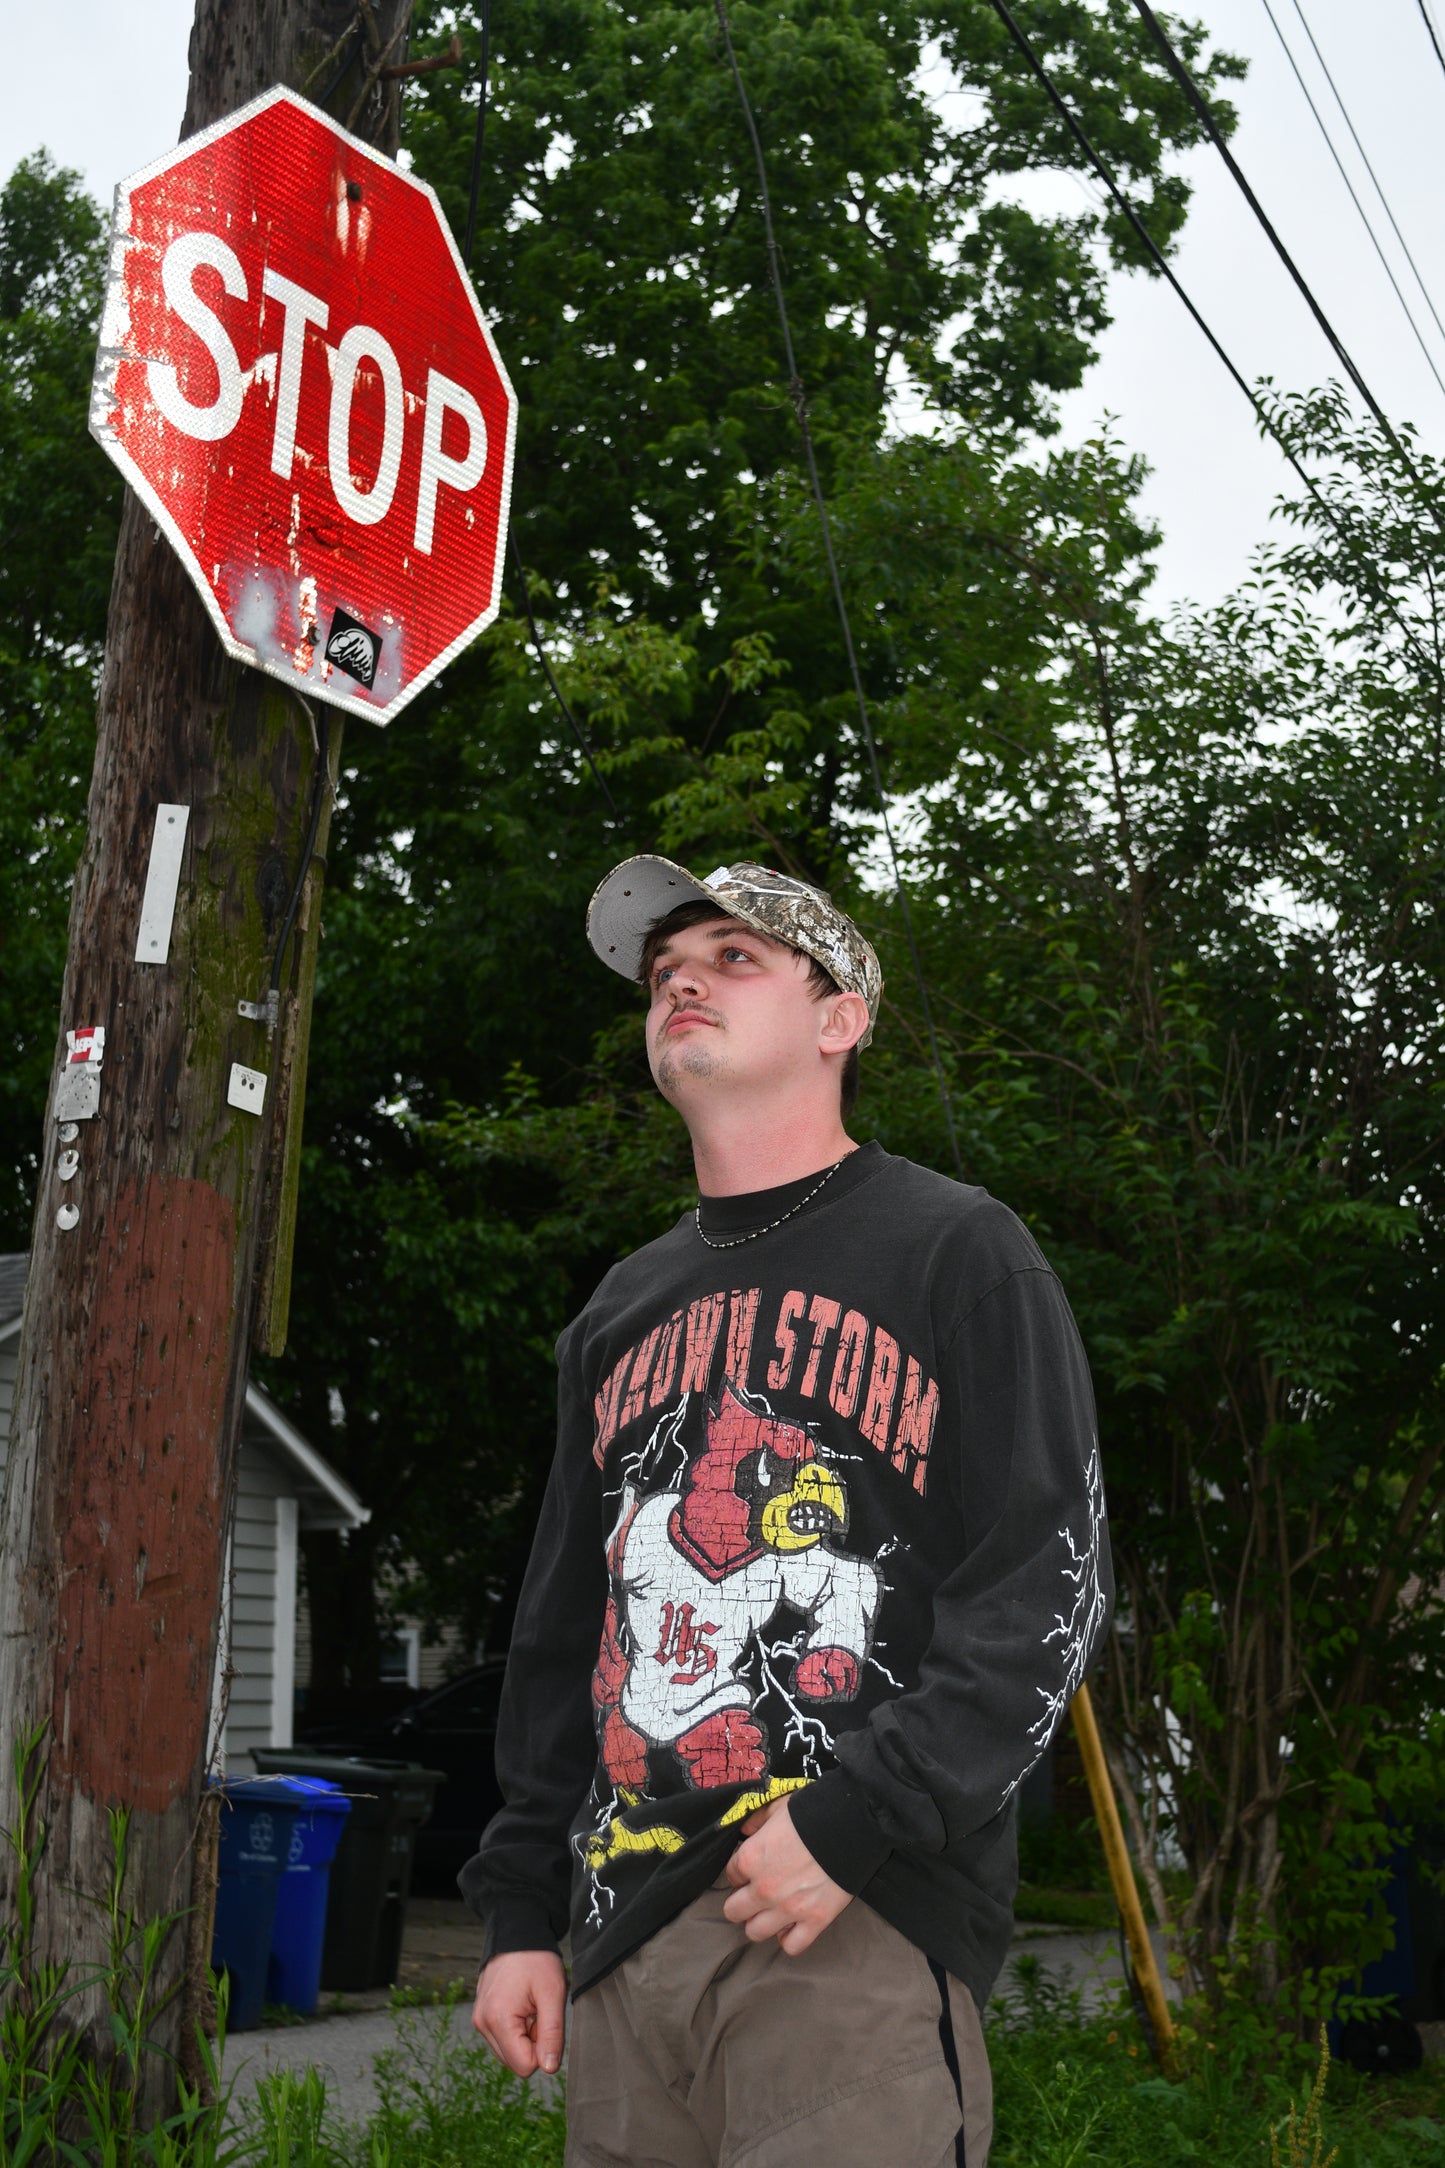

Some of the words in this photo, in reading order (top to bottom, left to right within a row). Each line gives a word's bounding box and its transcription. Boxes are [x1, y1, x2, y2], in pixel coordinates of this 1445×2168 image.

[147, 231, 488, 556] STOP
[592, 1287, 762, 1471] NKNOWN
[766, 1289, 941, 1497] STORM
